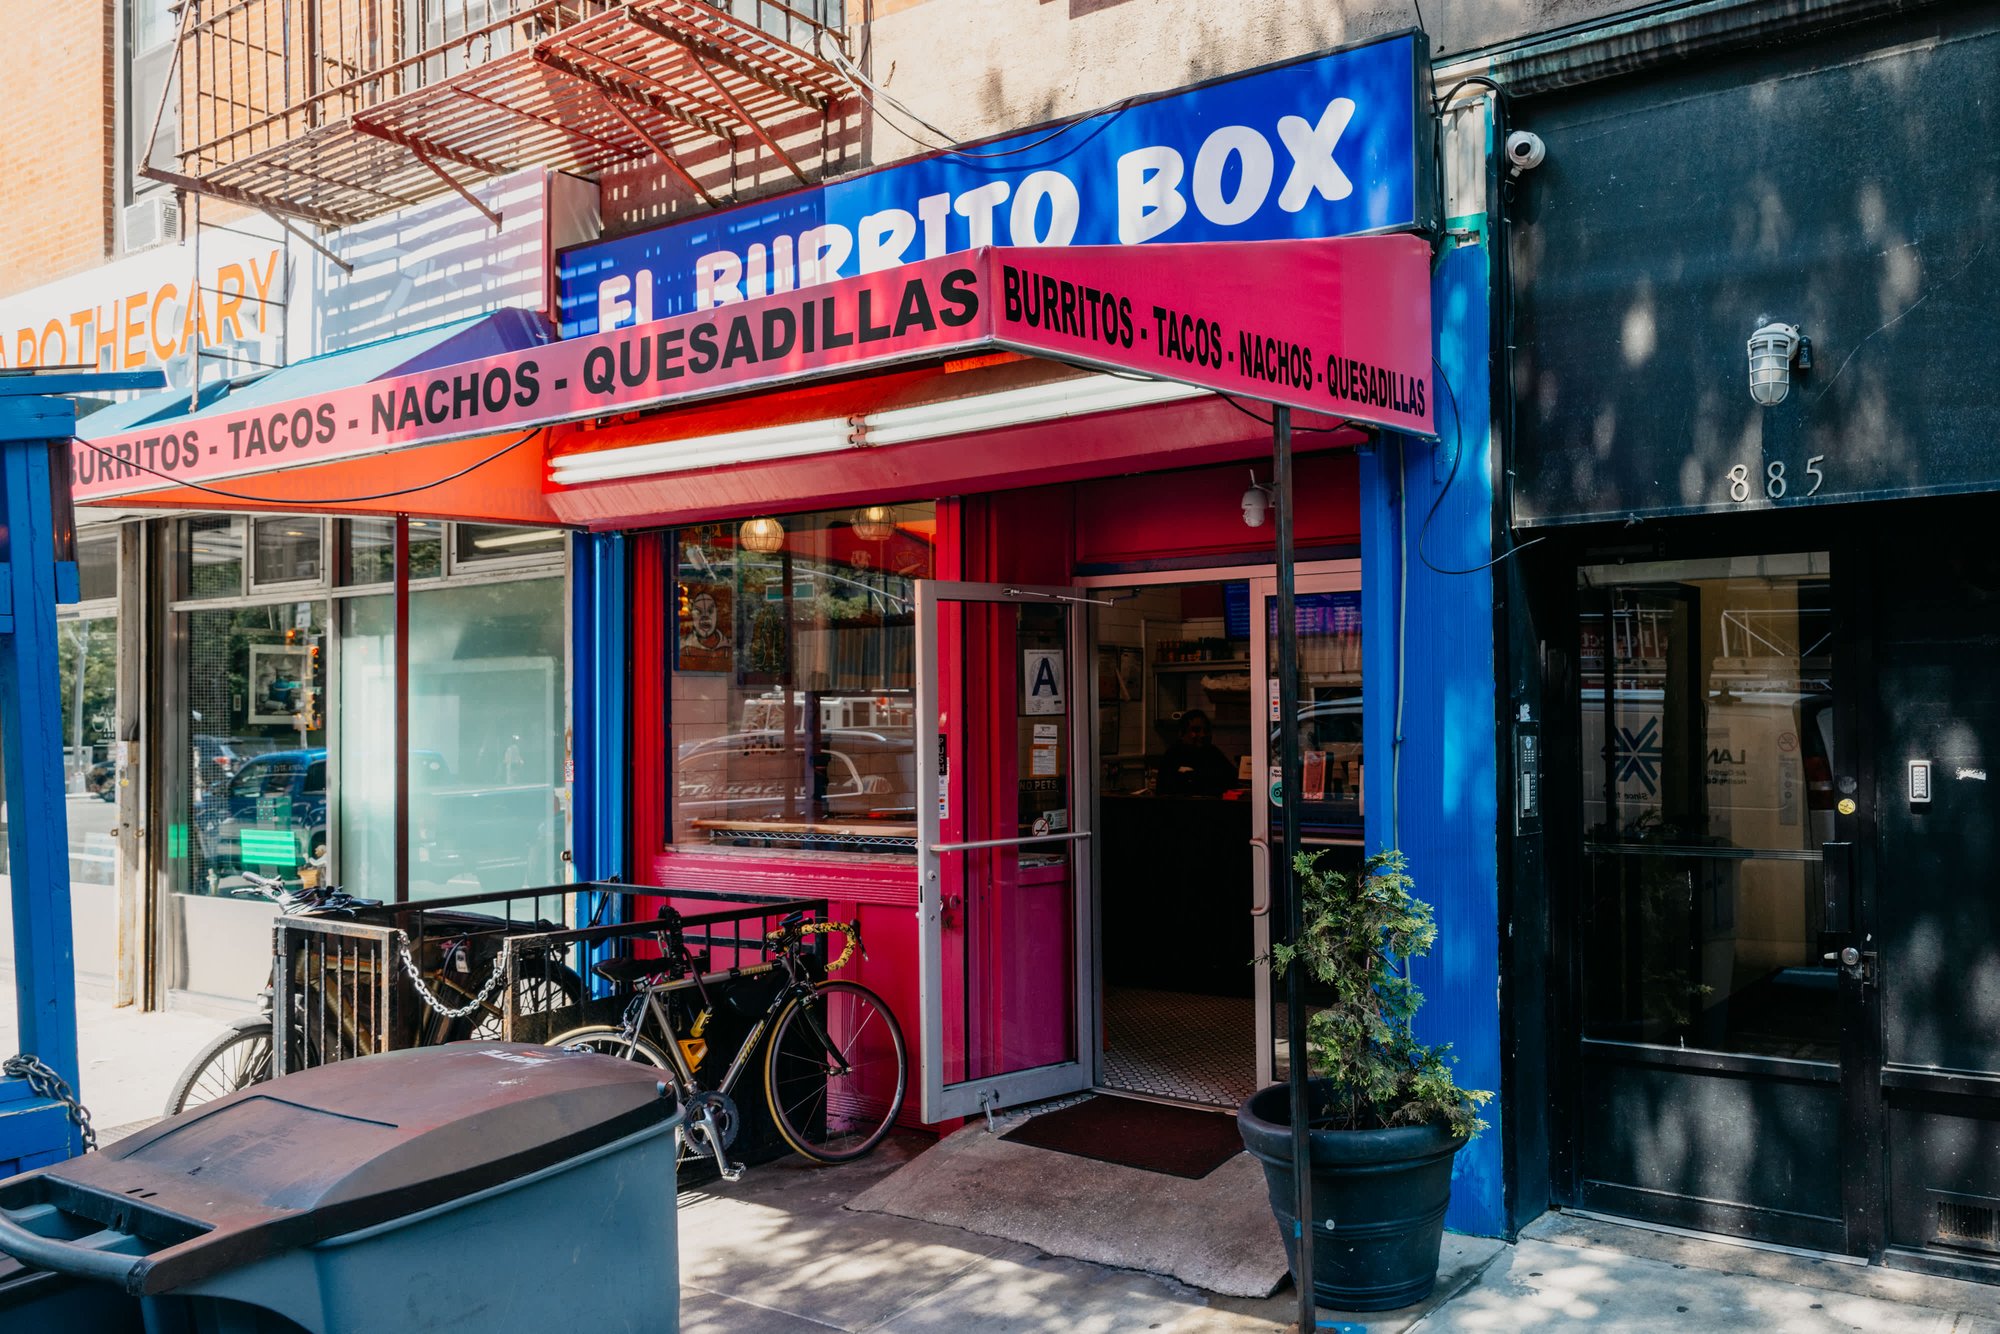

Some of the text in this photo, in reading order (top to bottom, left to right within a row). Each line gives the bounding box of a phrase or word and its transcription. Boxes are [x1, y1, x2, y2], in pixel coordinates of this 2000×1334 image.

[697, 170, 1080, 311] BURRITO
[1117, 97, 1356, 244] BOX
[0, 249, 279, 372] POTHECARY
[227, 403, 336, 460] TACOS
[371, 360, 540, 434] NACHOS
[584, 269, 979, 395] QUESADILLAS
[1003, 265, 1134, 349] BURRITOS
[1153, 306, 1222, 369] TACOS
[1239, 331, 1313, 391] NACHOS
[1327, 354, 1425, 417] QUESADILLAS
[1726, 454, 1824, 502] 885
[1032, 658, 1059, 696] A
[1034, 779, 1057, 790] PETS
